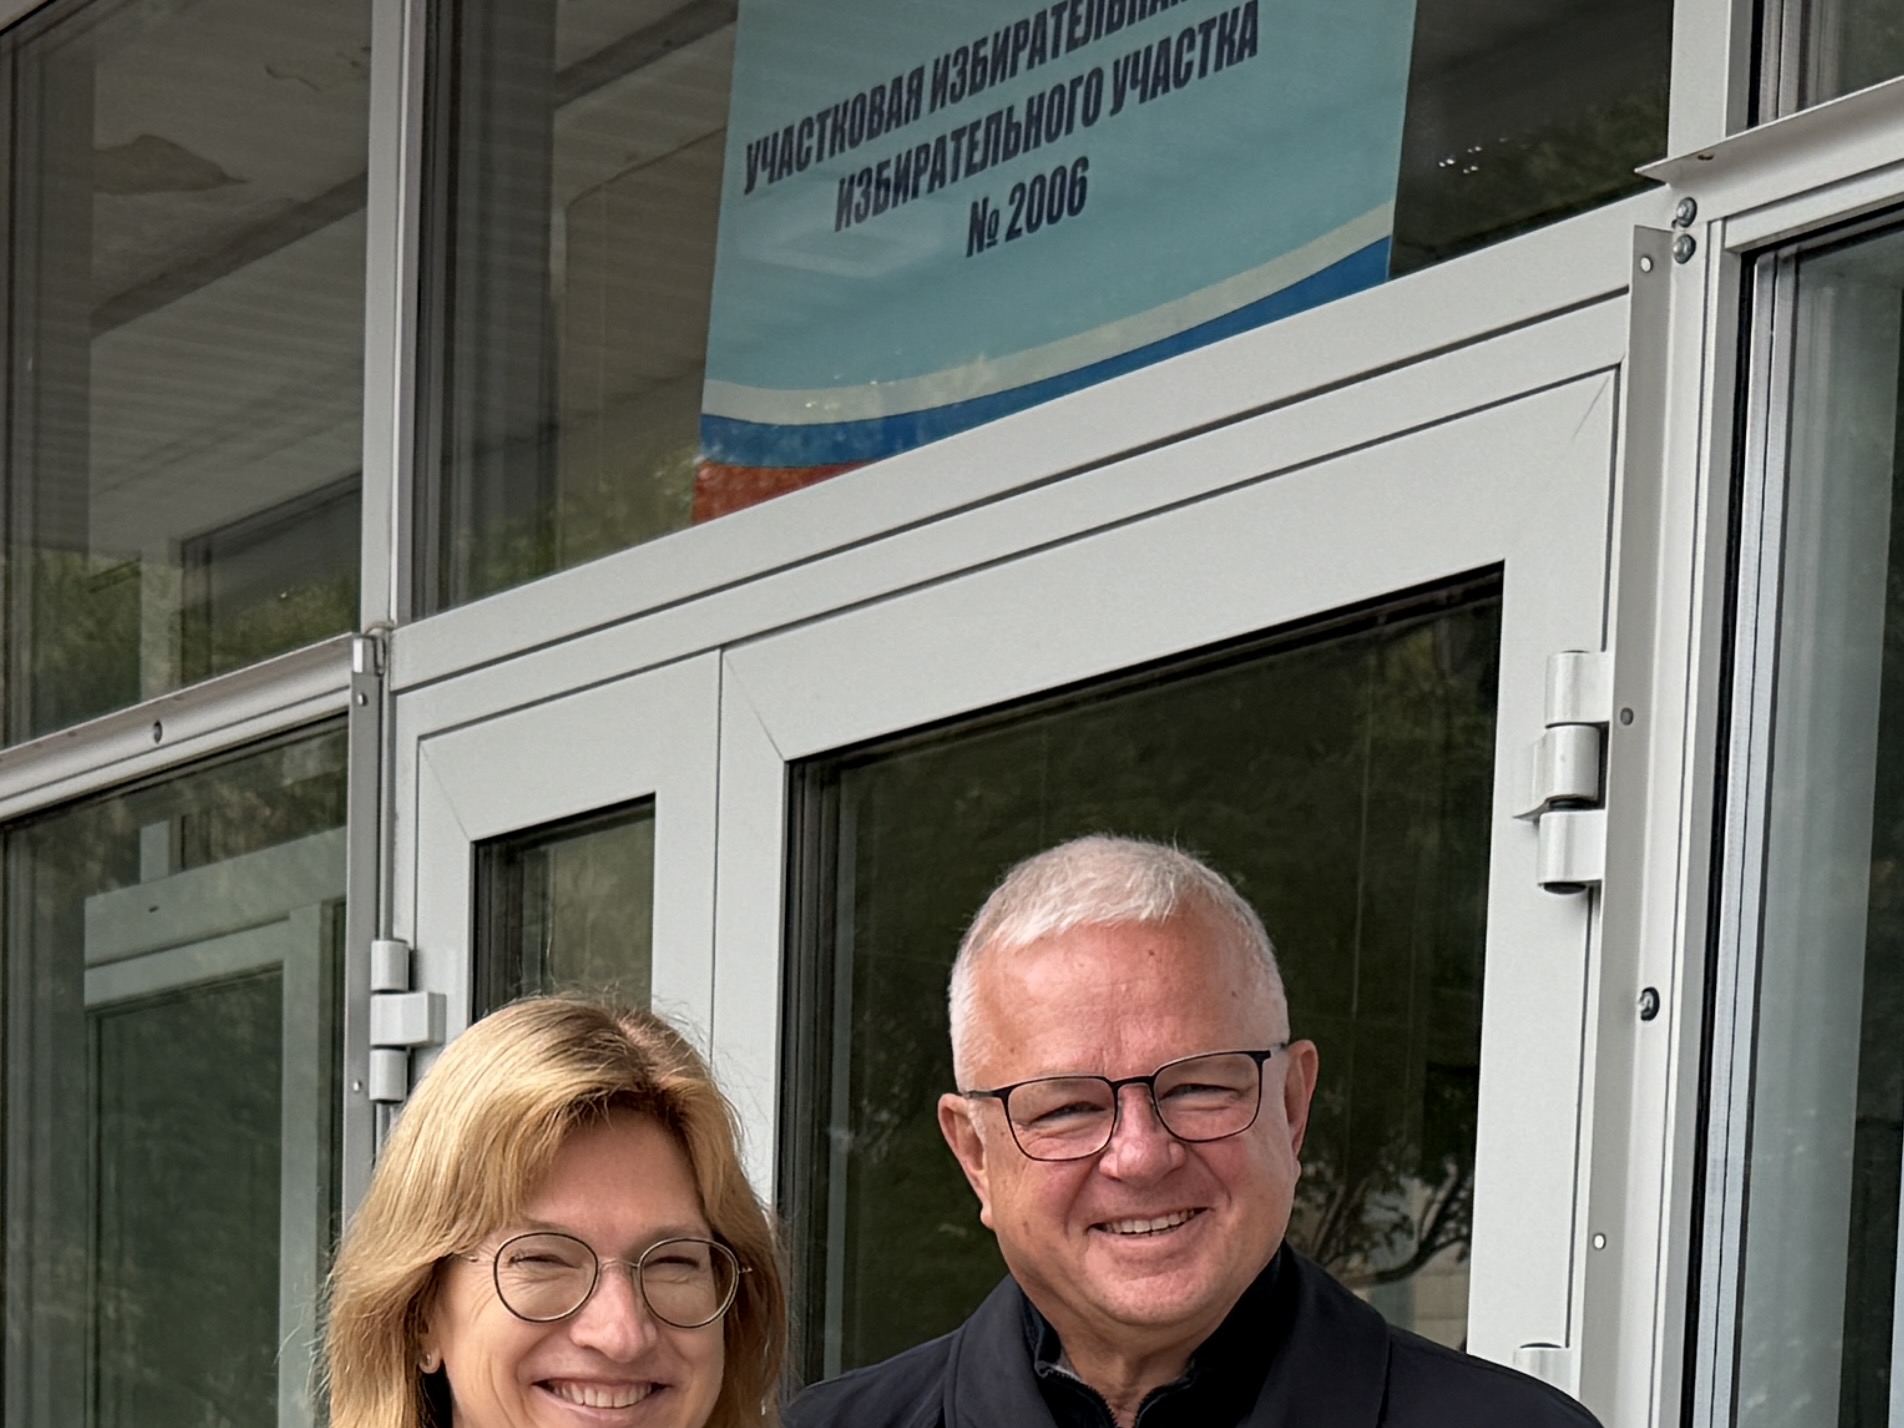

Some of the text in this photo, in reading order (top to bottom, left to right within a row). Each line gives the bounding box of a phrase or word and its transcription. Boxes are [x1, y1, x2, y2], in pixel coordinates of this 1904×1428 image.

[744, 0, 1189, 196] УЧАСТКОВАЯ ИЗБИРАТЕЛЬ
[834, 0, 1259, 233] ИЗБИРАТЕЛЬНОГО УЧАСТКА
[965, 155, 1090, 258] № 2006
